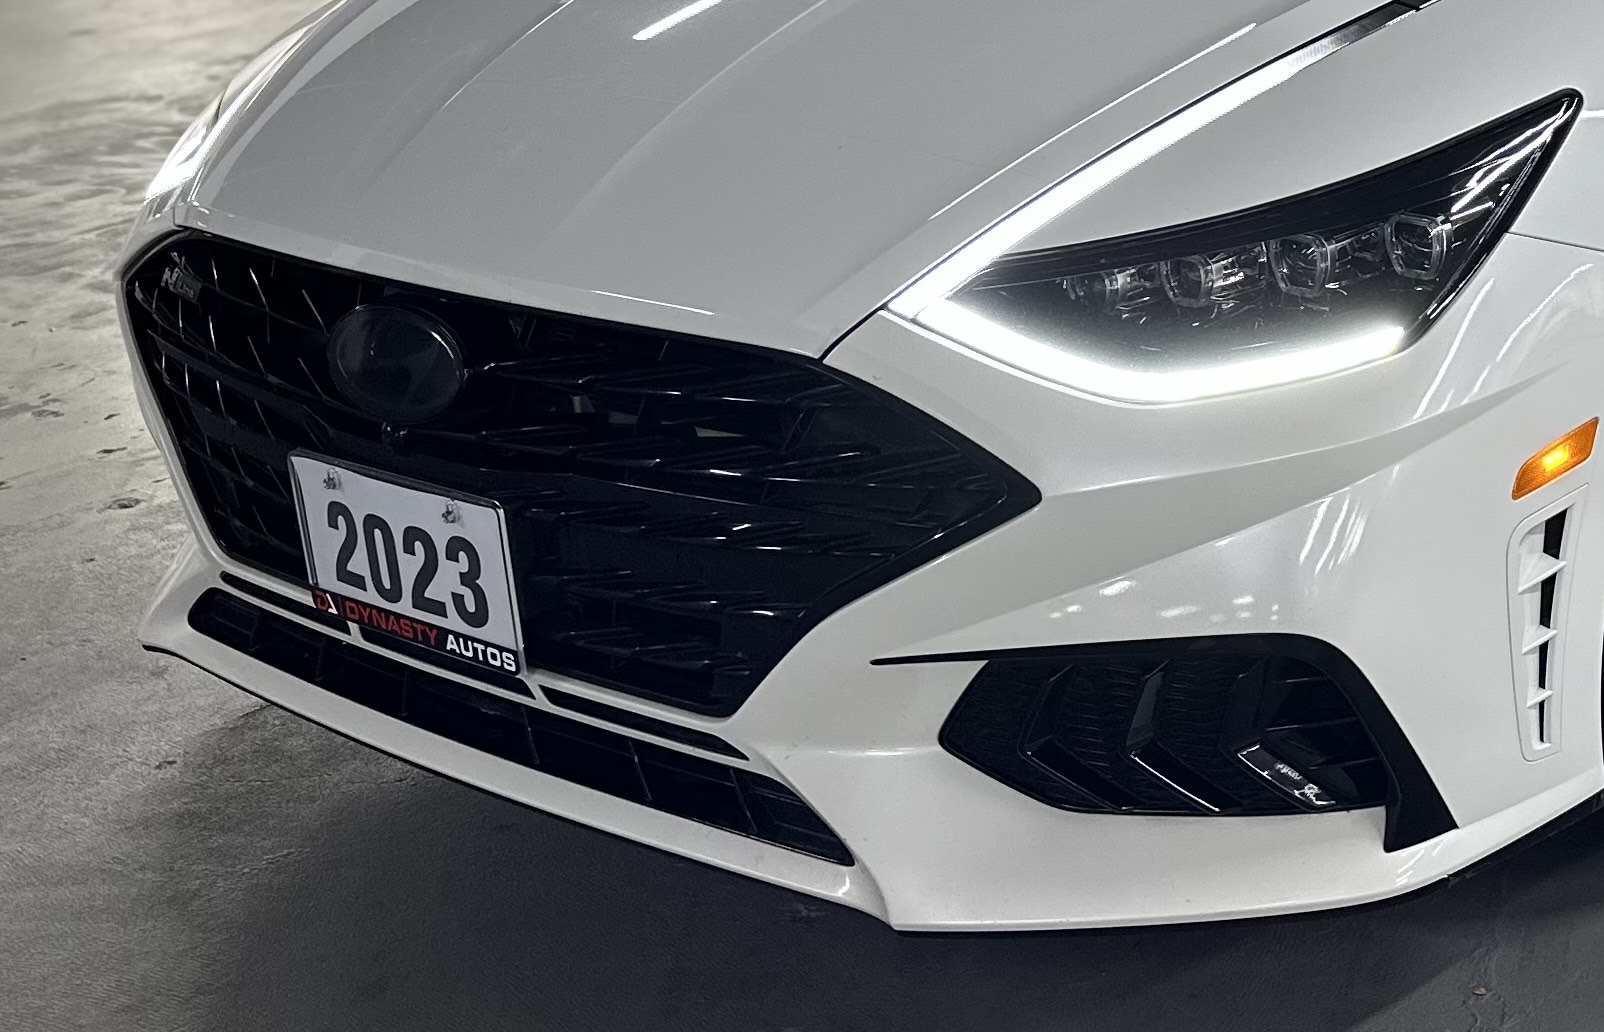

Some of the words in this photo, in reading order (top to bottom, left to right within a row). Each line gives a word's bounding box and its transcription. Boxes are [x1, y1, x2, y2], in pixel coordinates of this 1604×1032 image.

[327, 500, 489, 629] 2023
[345, 601, 438, 646] DYNASTY
[446, 634, 516, 672] AUTOS
